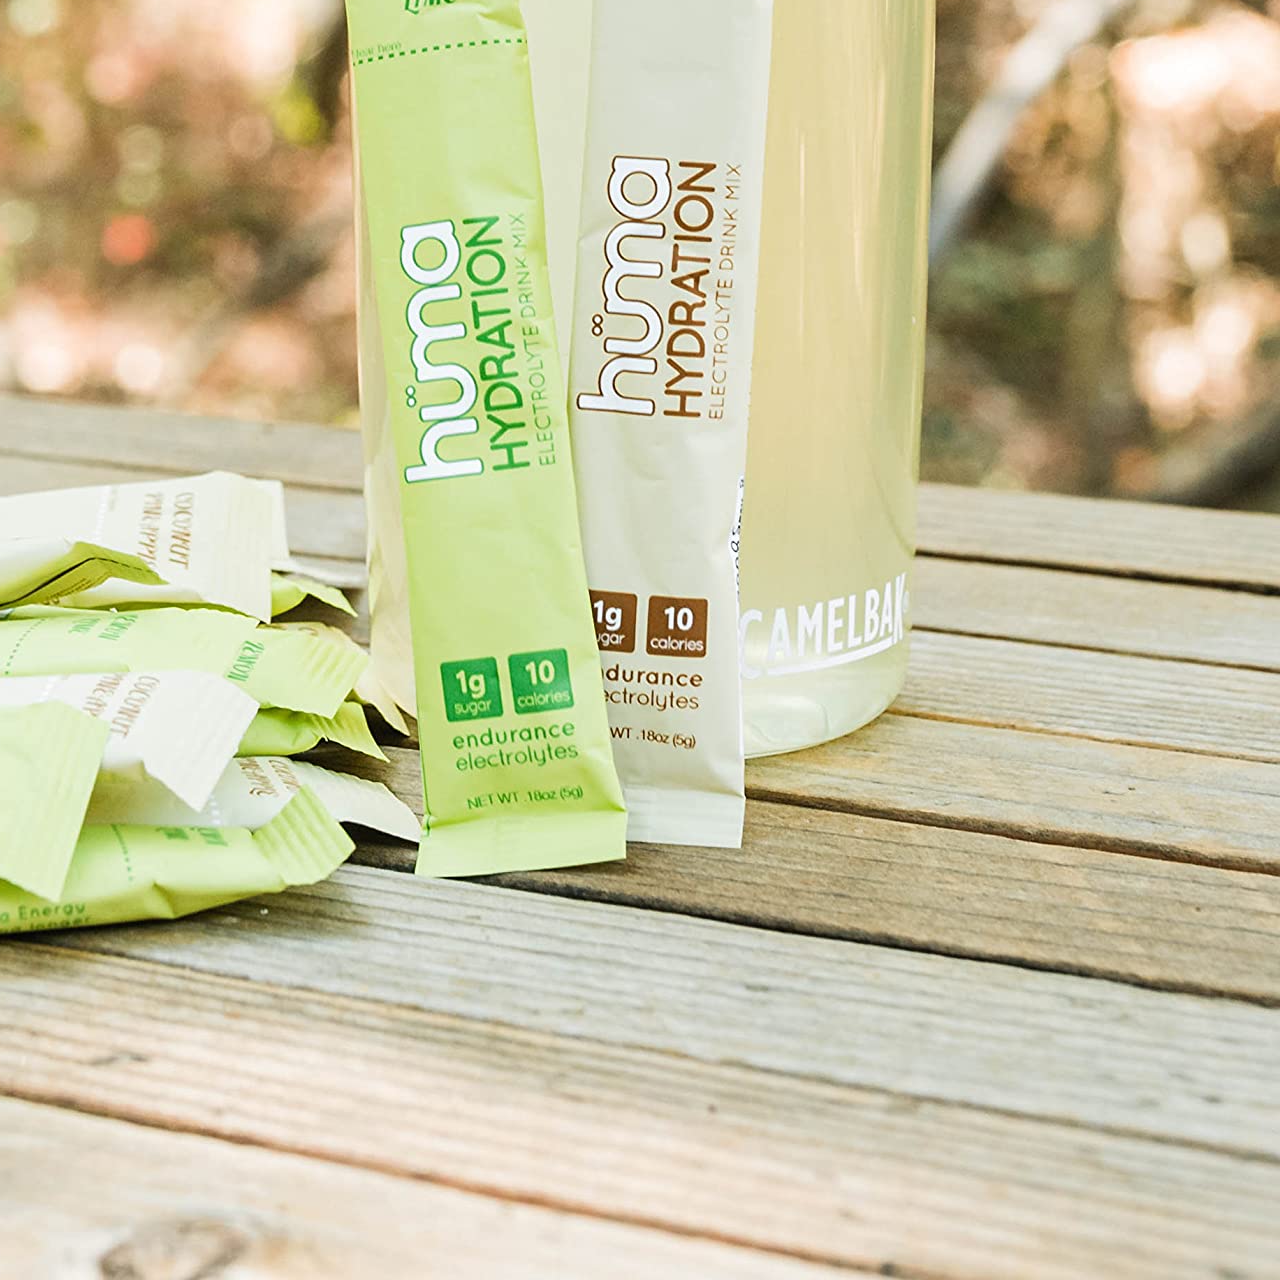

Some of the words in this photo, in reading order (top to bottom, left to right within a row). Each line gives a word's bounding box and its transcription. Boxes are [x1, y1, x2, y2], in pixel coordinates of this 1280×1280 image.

[725, 162, 742, 200] MIX
[509, 213, 528, 250] MIX
[718, 207, 739, 271] DRINK
[514, 256, 537, 319] DRINK
[576, 155, 673, 417] hüma
[663, 161, 717, 419] HYDRATION
[399, 219, 484, 484] hüma
[462, 215, 531, 471] HYDRATION
[708, 278, 734, 421] ELECTROLYTE
[521, 324, 556, 467] ELECTROLYTE
[593, 599, 622, 631] 1g
[664, 607, 694, 632] 10
[738, 572, 907, 680] CAMELBAK
[597, 632, 626, 647] gar
[649, 636, 704, 652] calories
[455, 670, 486, 699] 1g
[524, 659, 556, 686] 10
[601, 663, 704, 687] durance
[454, 699, 492, 716] sugar
[517, 689, 569, 708] calories
[604, 688, 700, 712] ectrolytes
[452, 721, 576, 750] endurance
[610, 727, 632, 740] WT
[636, 729, 669, 745] .18oz
[672, 734, 696, 749] (5g)
[455, 743, 579, 771] electrolytes
[467, 793, 495, 809] NET
[496, 791, 519, 805] WT
[524, 787, 557, 802] .18oz
[559, 786, 584, 800] (5g)
[18, 901, 86, 921] Energy
